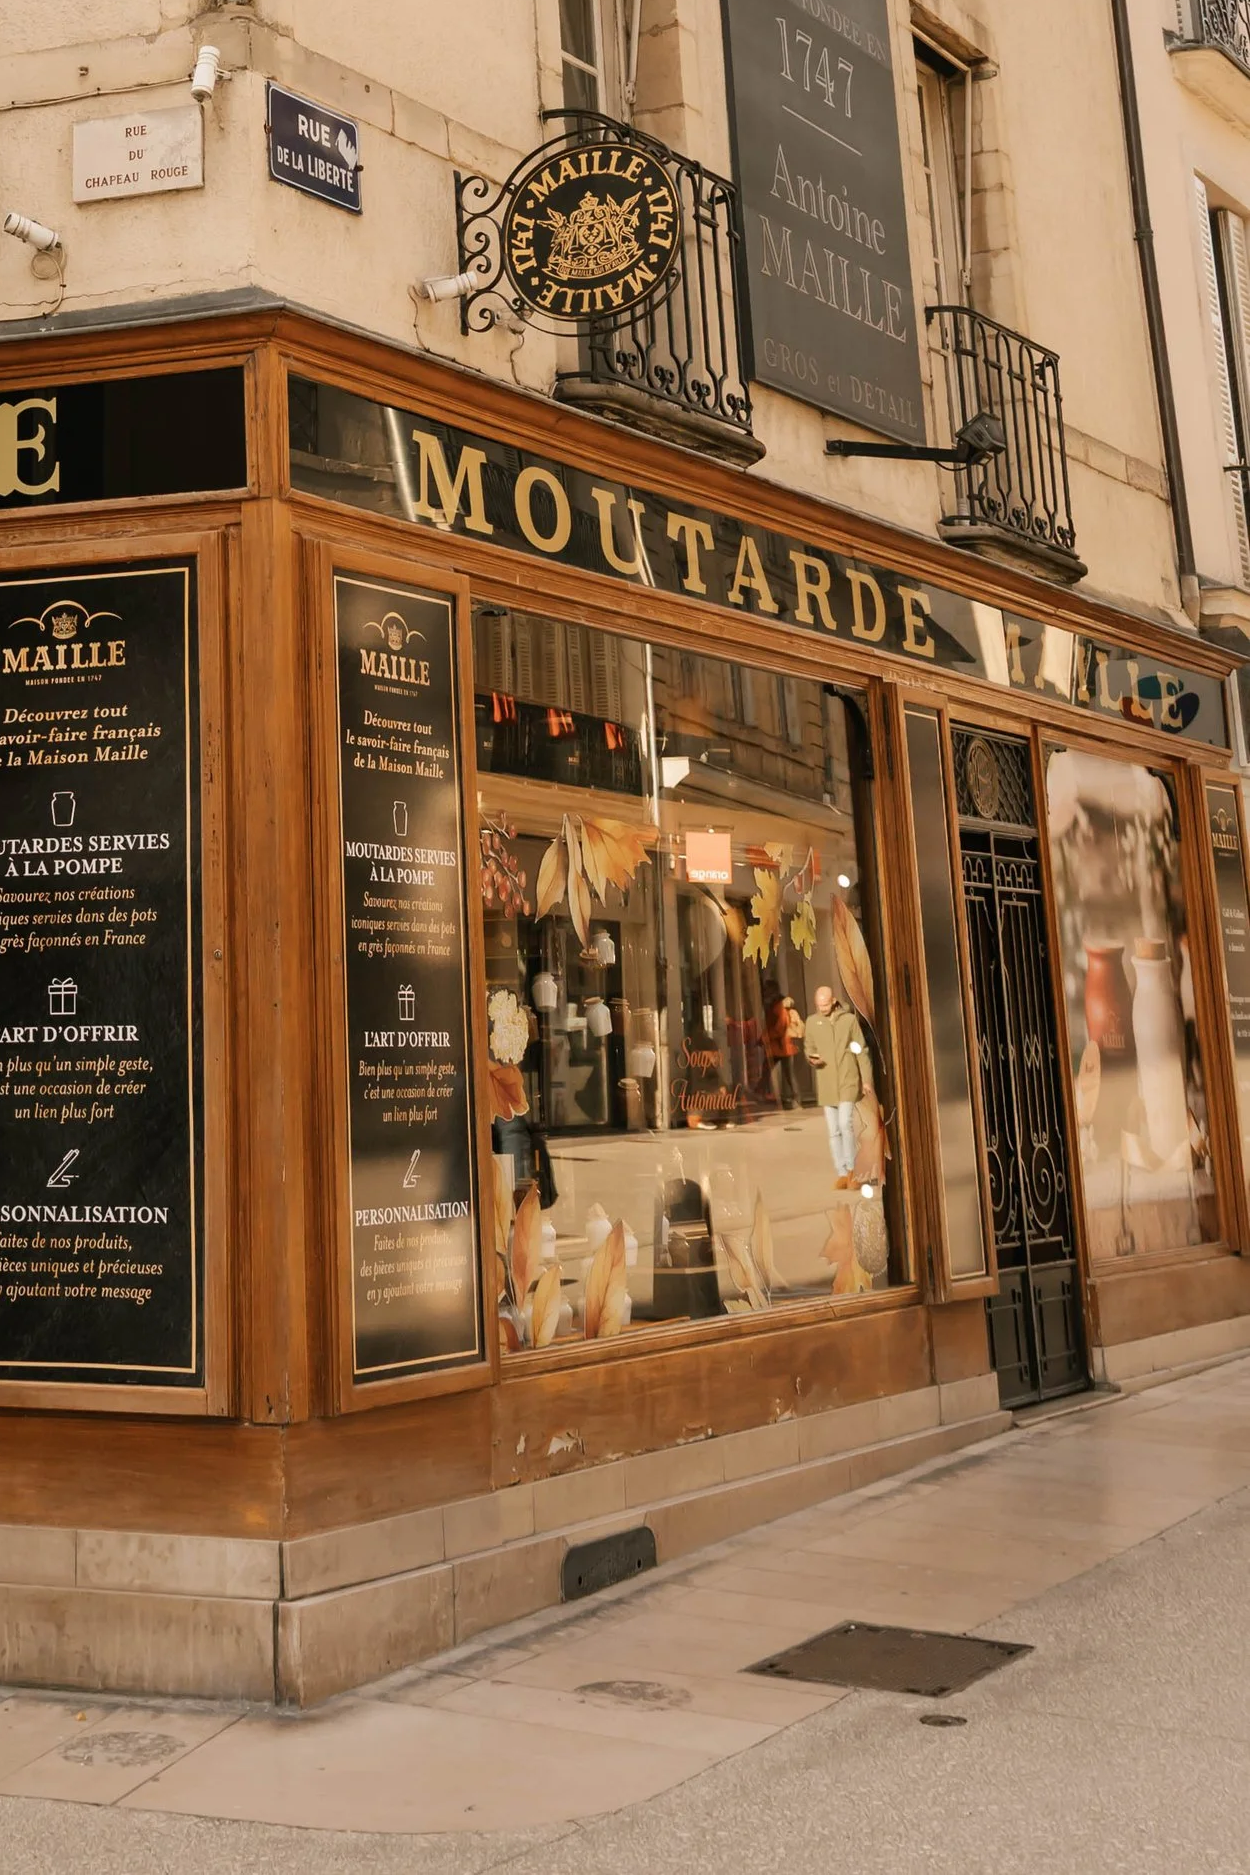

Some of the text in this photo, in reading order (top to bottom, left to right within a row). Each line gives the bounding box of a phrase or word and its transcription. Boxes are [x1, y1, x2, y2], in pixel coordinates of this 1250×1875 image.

[865, 32, 887, 62] EN
[775, 17, 854, 118] 1747
[125, 125, 147, 138] RUE
[298, 114, 331, 148] RUE
[129, 150, 144, 161] DU
[277, 145, 290, 166] DE
[291, 151, 304, 172] LA
[85, 165, 189, 189] CHAPEAU ROUGE
[527, 150, 648, 202] MAILLE
[769, 143, 887, 256] Antoine
[646, 186, 673, 250] 1747
[512, 213, 537, 275] 1747
[536, 260, 657, 313] MAILLE
[759, 214, 908, 344] MAILLE
[763, 338, 918, 429] GROS et DETAIL
[411, 429, 935, 659] MOUTARDE
[2, 640, 125, 673] MAILLE
[360, 648, 430, 686] MAILLE
[3, 704, 128, 723] Découvrez tout
[363, 709, 432, 735] Découvrez tout
[92, 722, 161, 742] français
[6, 751, 21, 766] la
[26, 749, 88, 765] Maison
[94, 744, 148, 761] Maille
[345, 732, 449, 760] le savoir-faire français
[353, 753, 444, 779] de la Maison Maille
[88, 833, 170, 852] SERVIES
[346, 841, 456, 866] MOUTARDES SERVIES
[4, 856, 123, 877] À LA POMPE
[369, 861, 435, 885] À LA POMPE
[54, 890, 75, 901] nos
[78, 885, 135, 900] créations
[32, 910, 72, 924] servies
[75, 908, 105, 923] dans
[107, 907, 128, 922] des
[129, 908, 157, 927] pots
[24, 932, 82, 953] façonnés
[84, 935, 99, 946] en
[103, 930, 146, 945] France
[5, 1055, 32, 1077] plus
[74, 1054, 116, 1076] simple
[117, 1056, 153, 1077] geste,
[13, 1084, 36, 1095] une
[39, 1080, 92, 1095] occasion
[96, 1078, 111, 1094] de
[114, 1079, 146, 1094] créer
[14, 1102, 114, 1124] un lien plus fort
[31, 1231, 46, 1248] de
[50, 1237, 71, 1248] nos
[73, 1232, 132, 1254] produits,
[30, 1258, 79, 1278] uniques
[82, 1259, 94, 1273] et
[97, 1259, 163, 1279] précieuses
[5, 1282, 60, 1302] ajoutant
[64, 1283, 97, 1297] votre
[101, 1286, 152, 1305] message
